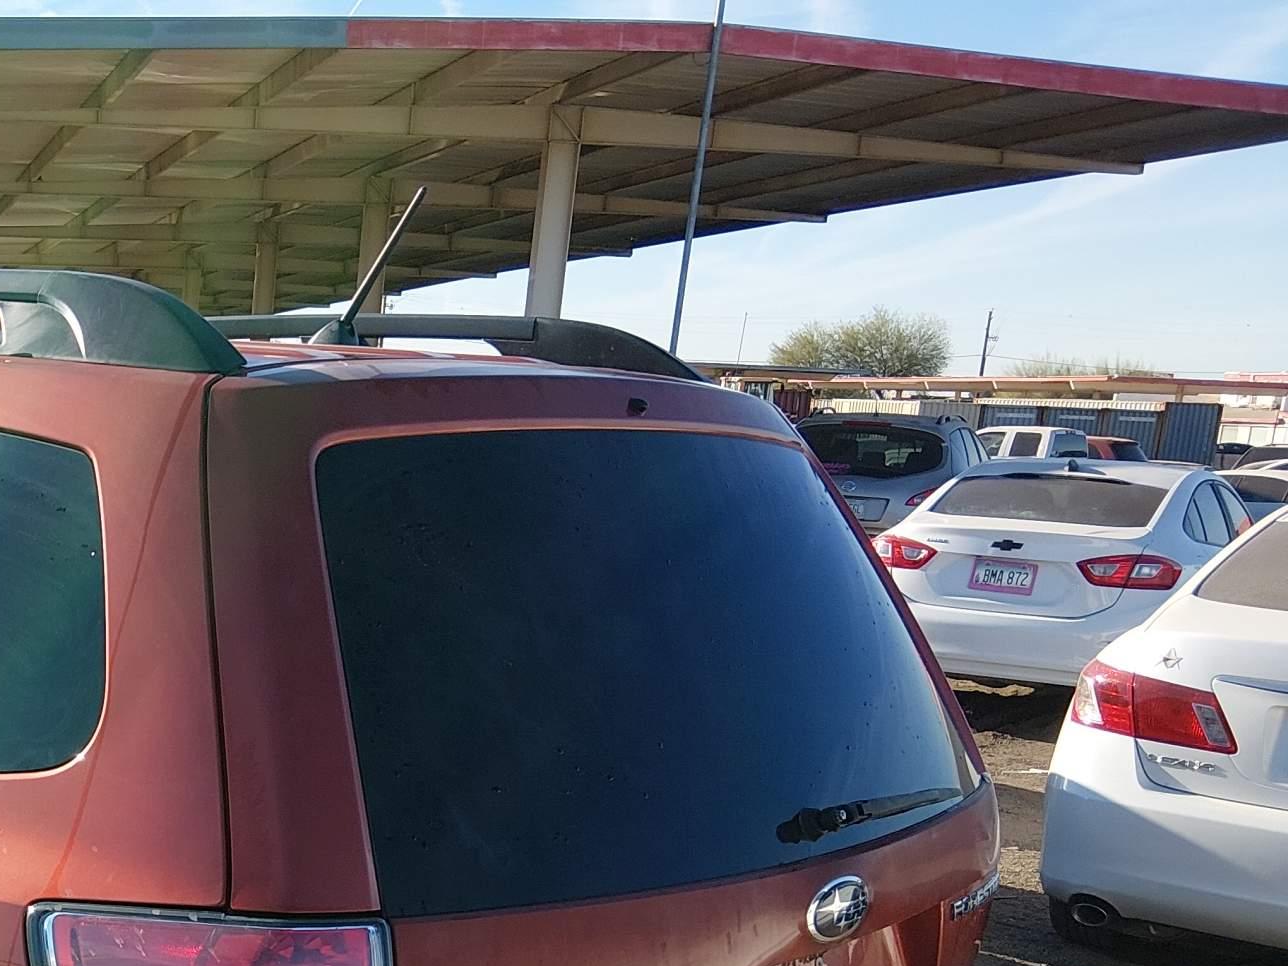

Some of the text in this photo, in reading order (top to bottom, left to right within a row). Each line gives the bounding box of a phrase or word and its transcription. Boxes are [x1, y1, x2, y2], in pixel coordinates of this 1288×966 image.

[982, 568, 1029, 587] BMA 872
[953, 872, 999, 921] FOREST
